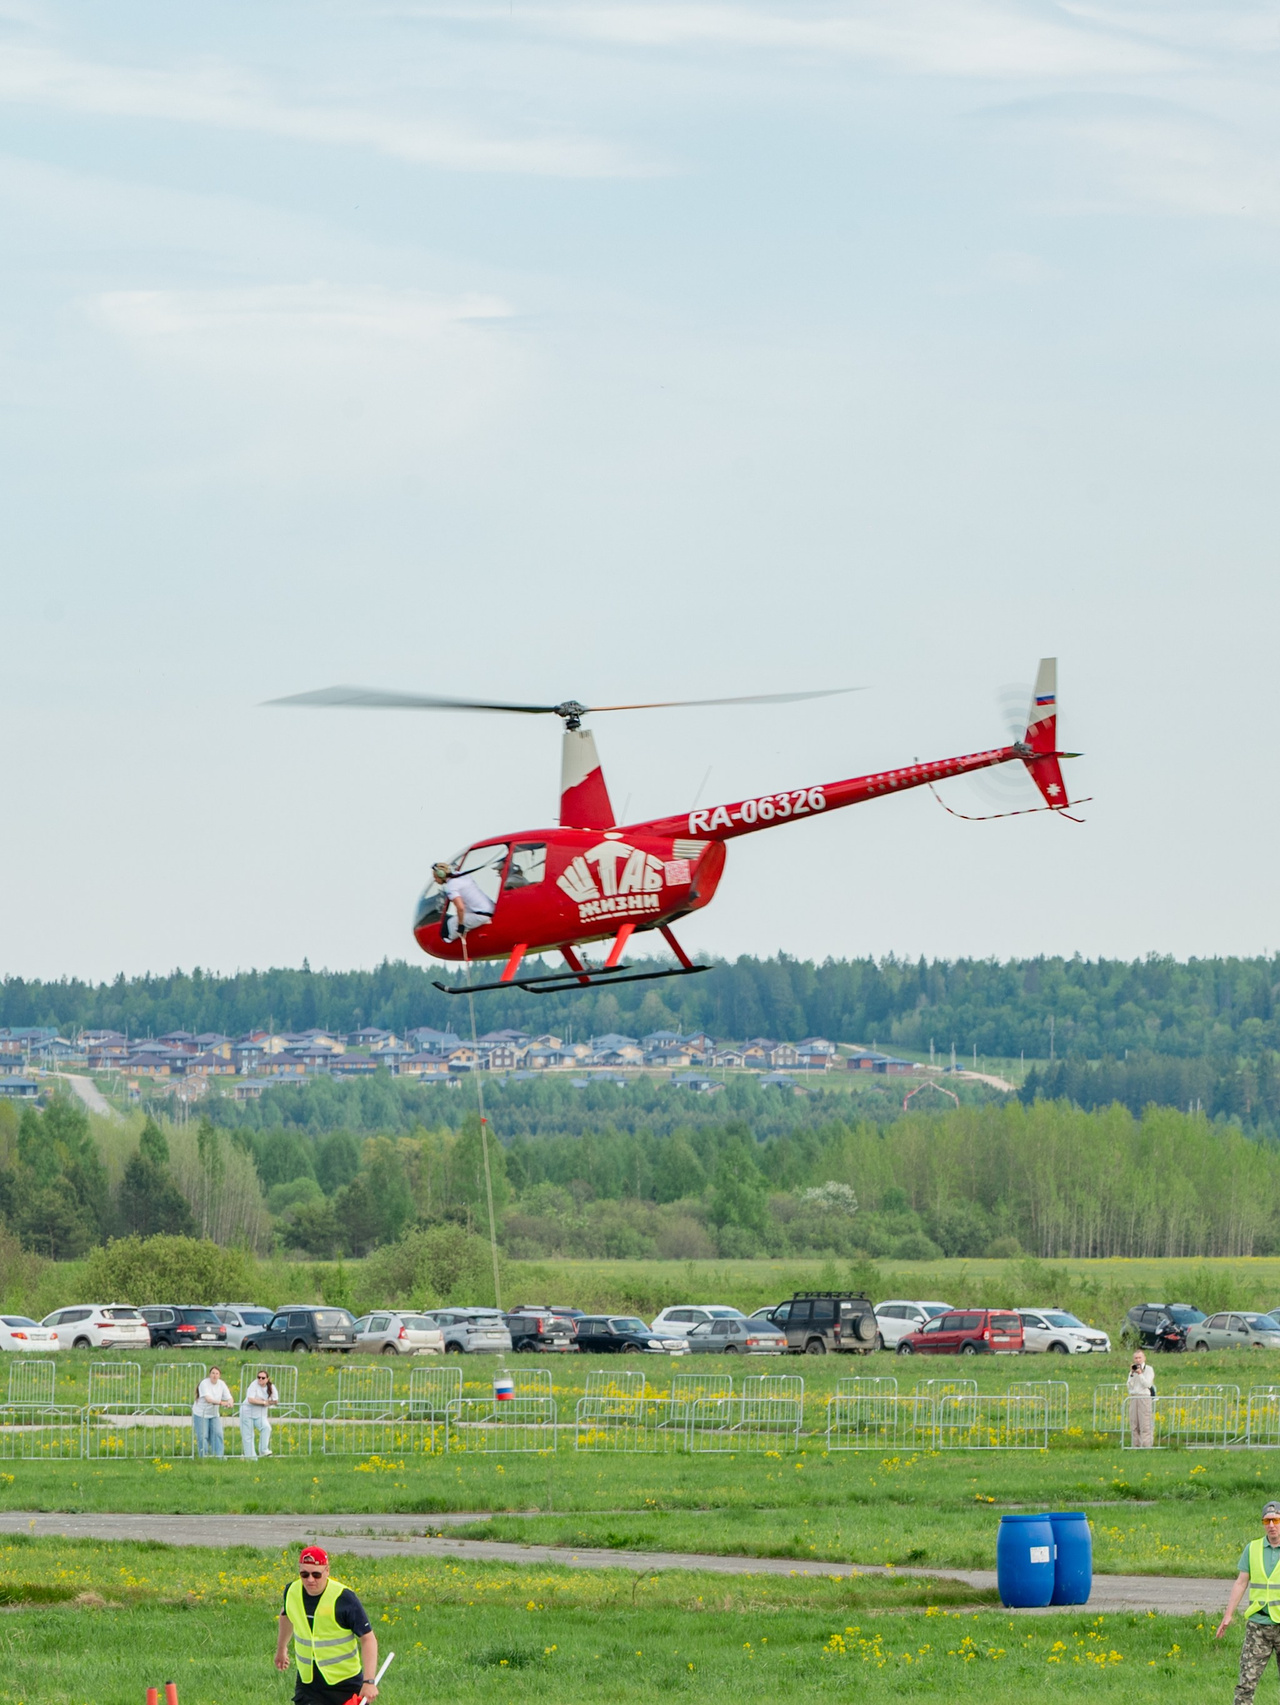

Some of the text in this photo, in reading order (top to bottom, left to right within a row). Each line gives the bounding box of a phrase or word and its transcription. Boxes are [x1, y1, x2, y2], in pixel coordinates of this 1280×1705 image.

[688, 786, 827, 835] RA-06326
[556, 840, 665, 903] ШТАБ
[578, 893, 660, 918] ЖИЗНИ
